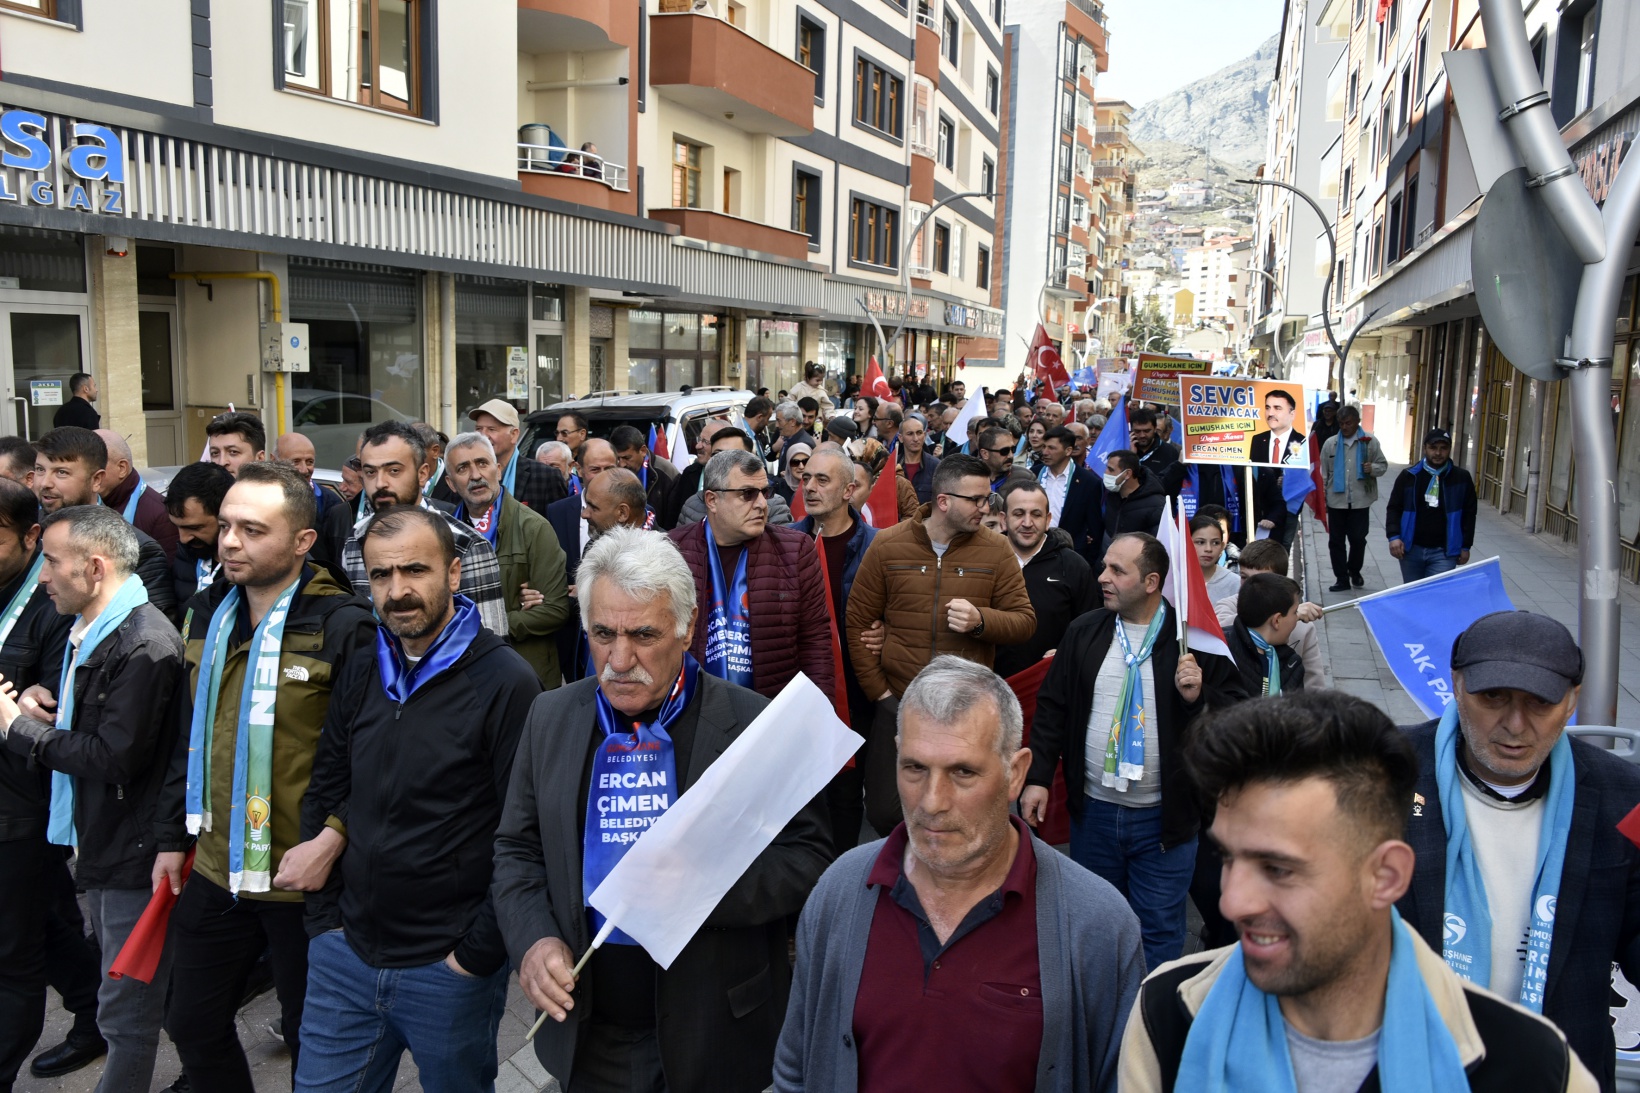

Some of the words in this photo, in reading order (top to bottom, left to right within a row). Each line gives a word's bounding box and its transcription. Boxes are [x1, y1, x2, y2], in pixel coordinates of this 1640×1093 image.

[1142, 378, 1166, 386] ERCAN
[1188, 405, 1259, 419] KAZANACAK
[1192, 444, 1218, 453] ERCAN
[1403, 643, 1436, 673] AK
[599, 771, 667, 788] ERCAN
